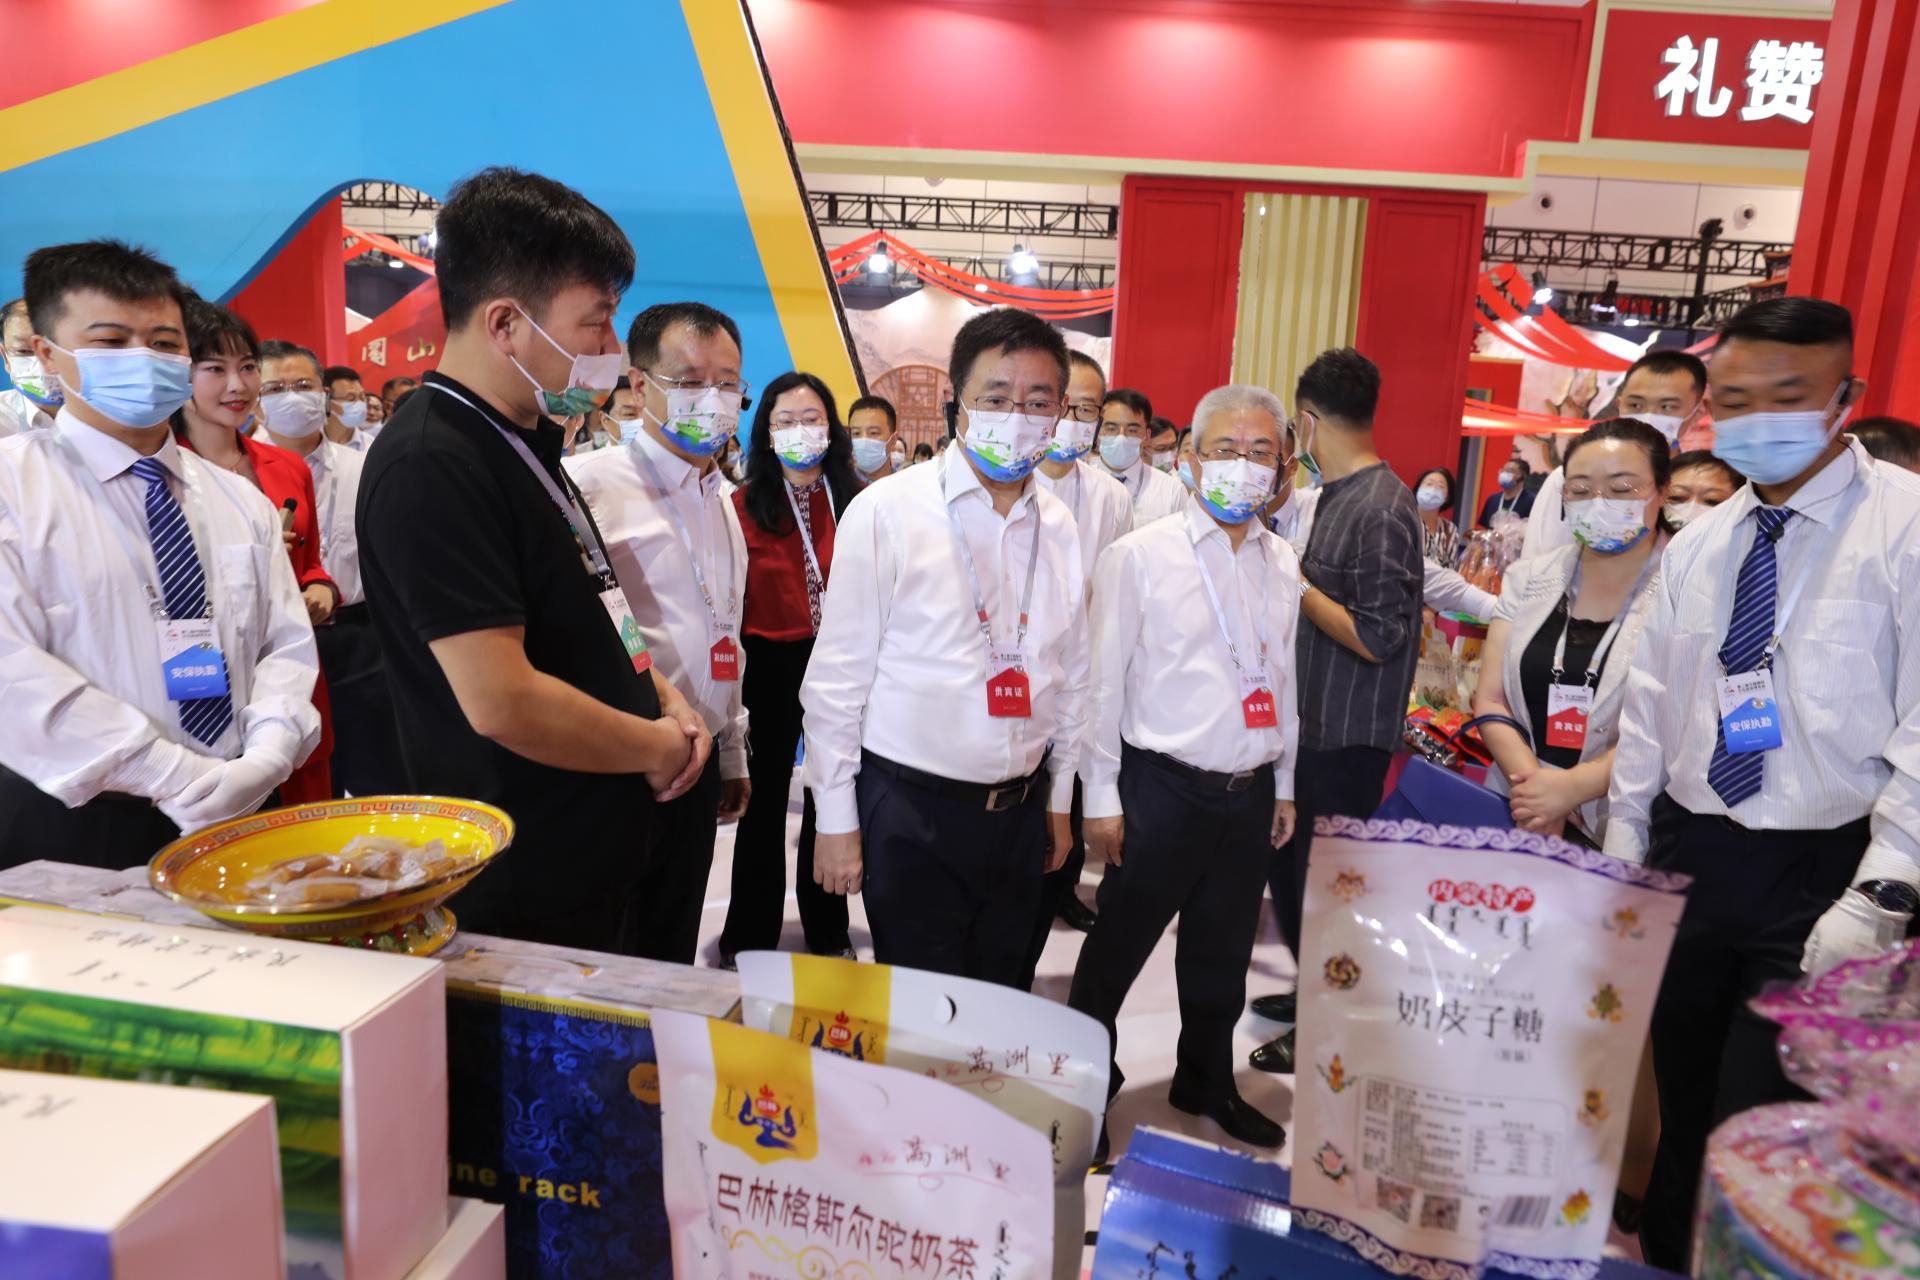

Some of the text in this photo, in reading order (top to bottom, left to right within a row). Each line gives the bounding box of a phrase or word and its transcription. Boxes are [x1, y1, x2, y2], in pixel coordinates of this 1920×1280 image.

[1656, 35, 1824, 125] 礼赞
[995, 686, 1023, 698] 贵宾证
[1729, 715, 1772, 733] 安保执勤
[1396, 989, 1544, 1044] 奶皮子糖
[518, 1174, 601, 1209] rack
[717, 1173, 979, 1280] 巴林格斯尔驼奶茶
